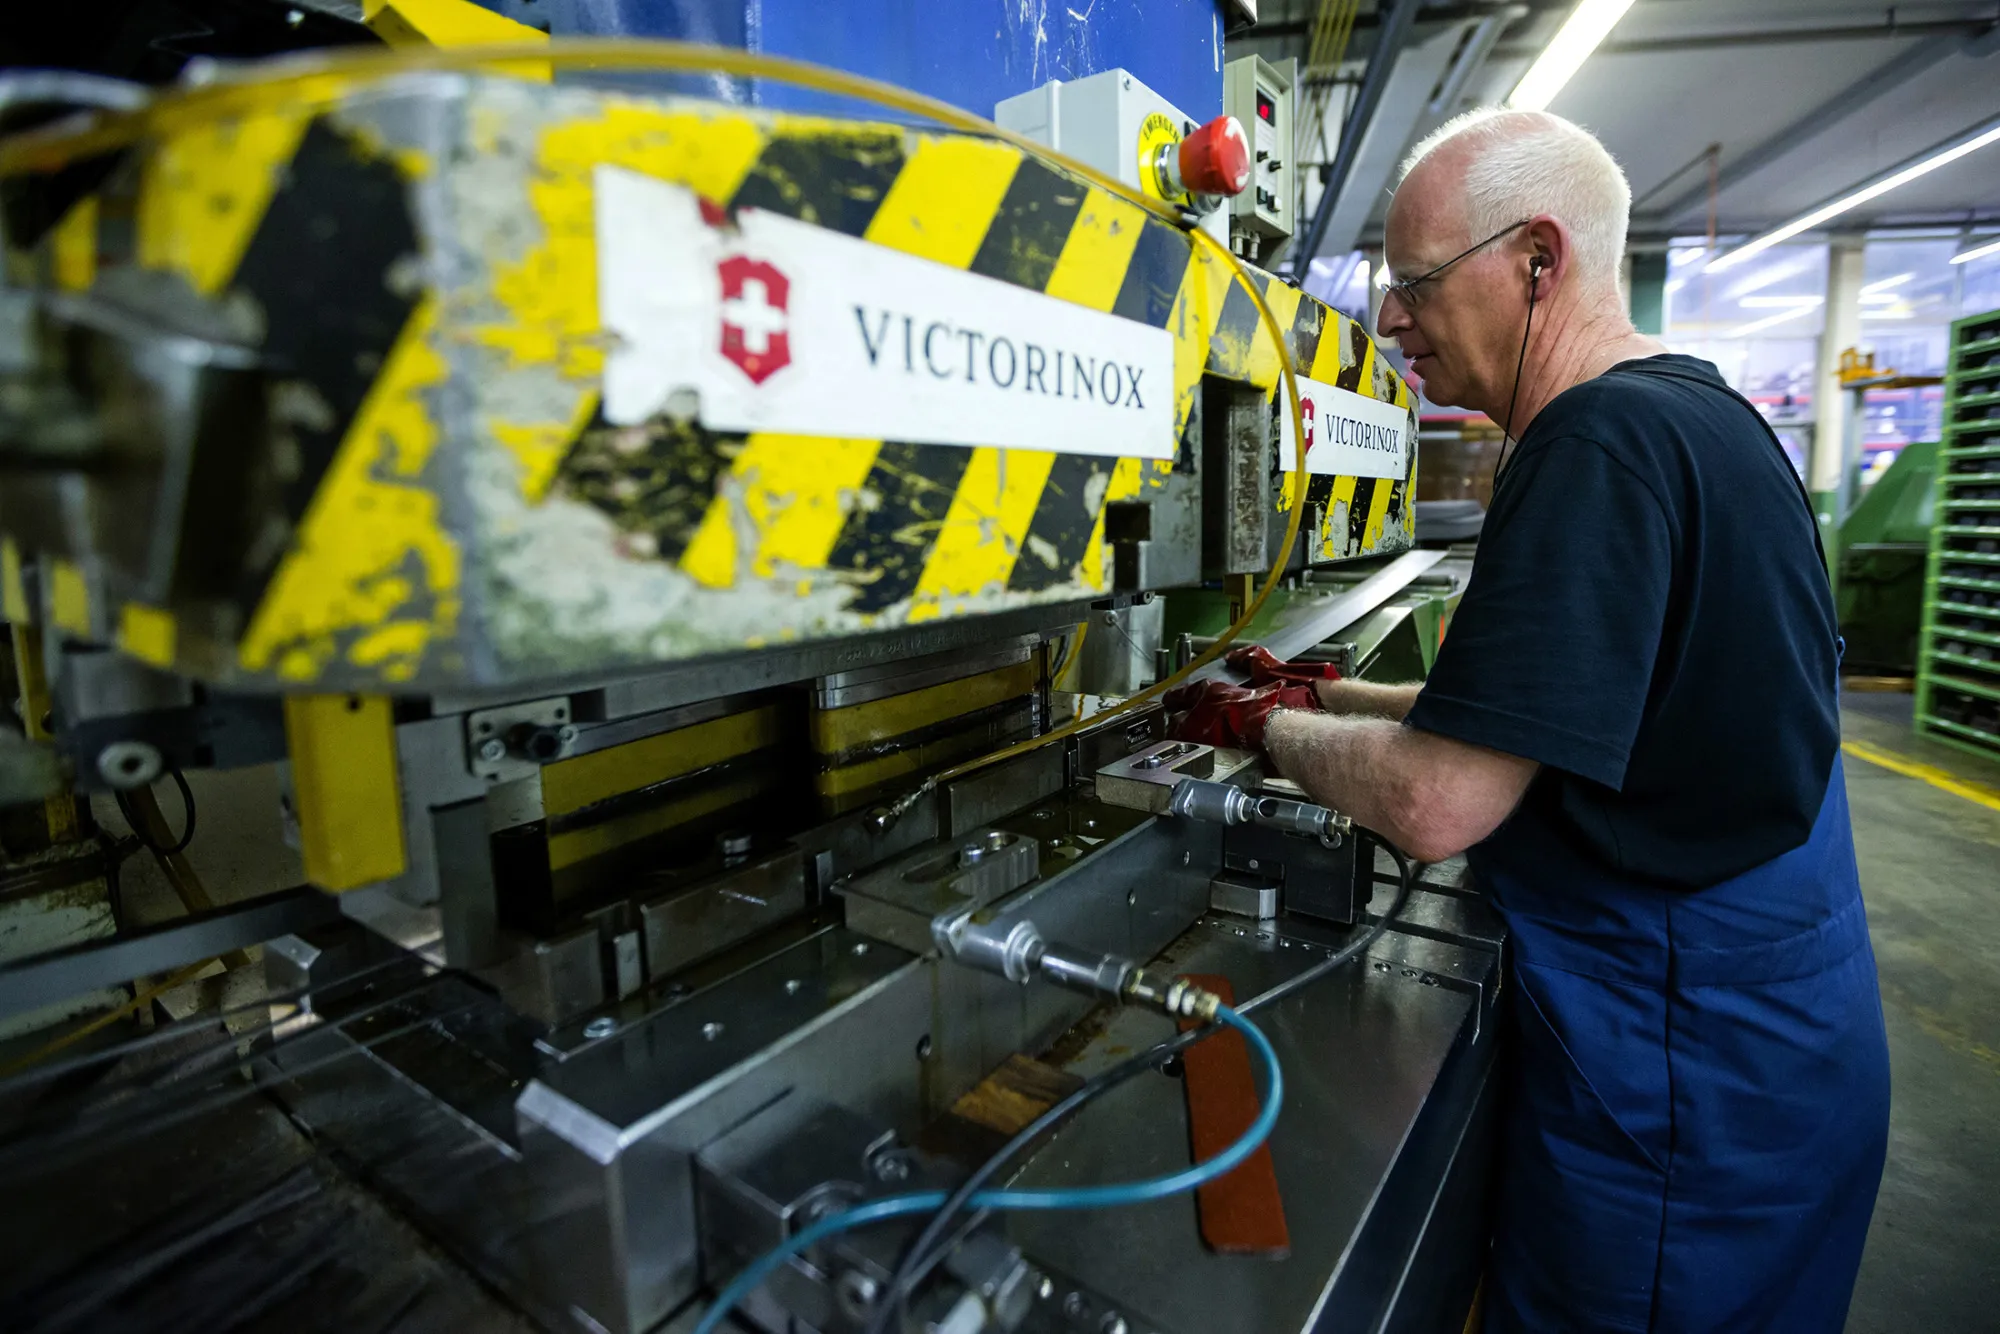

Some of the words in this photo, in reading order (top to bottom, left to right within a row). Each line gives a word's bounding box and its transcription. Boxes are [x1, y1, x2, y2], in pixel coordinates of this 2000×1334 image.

[1143, 115, 1180, 143] EMERGEN
[853, 304, 1146, 409] VICTORINOX
[1326, 413, 1399, 454] VICTORINOX
